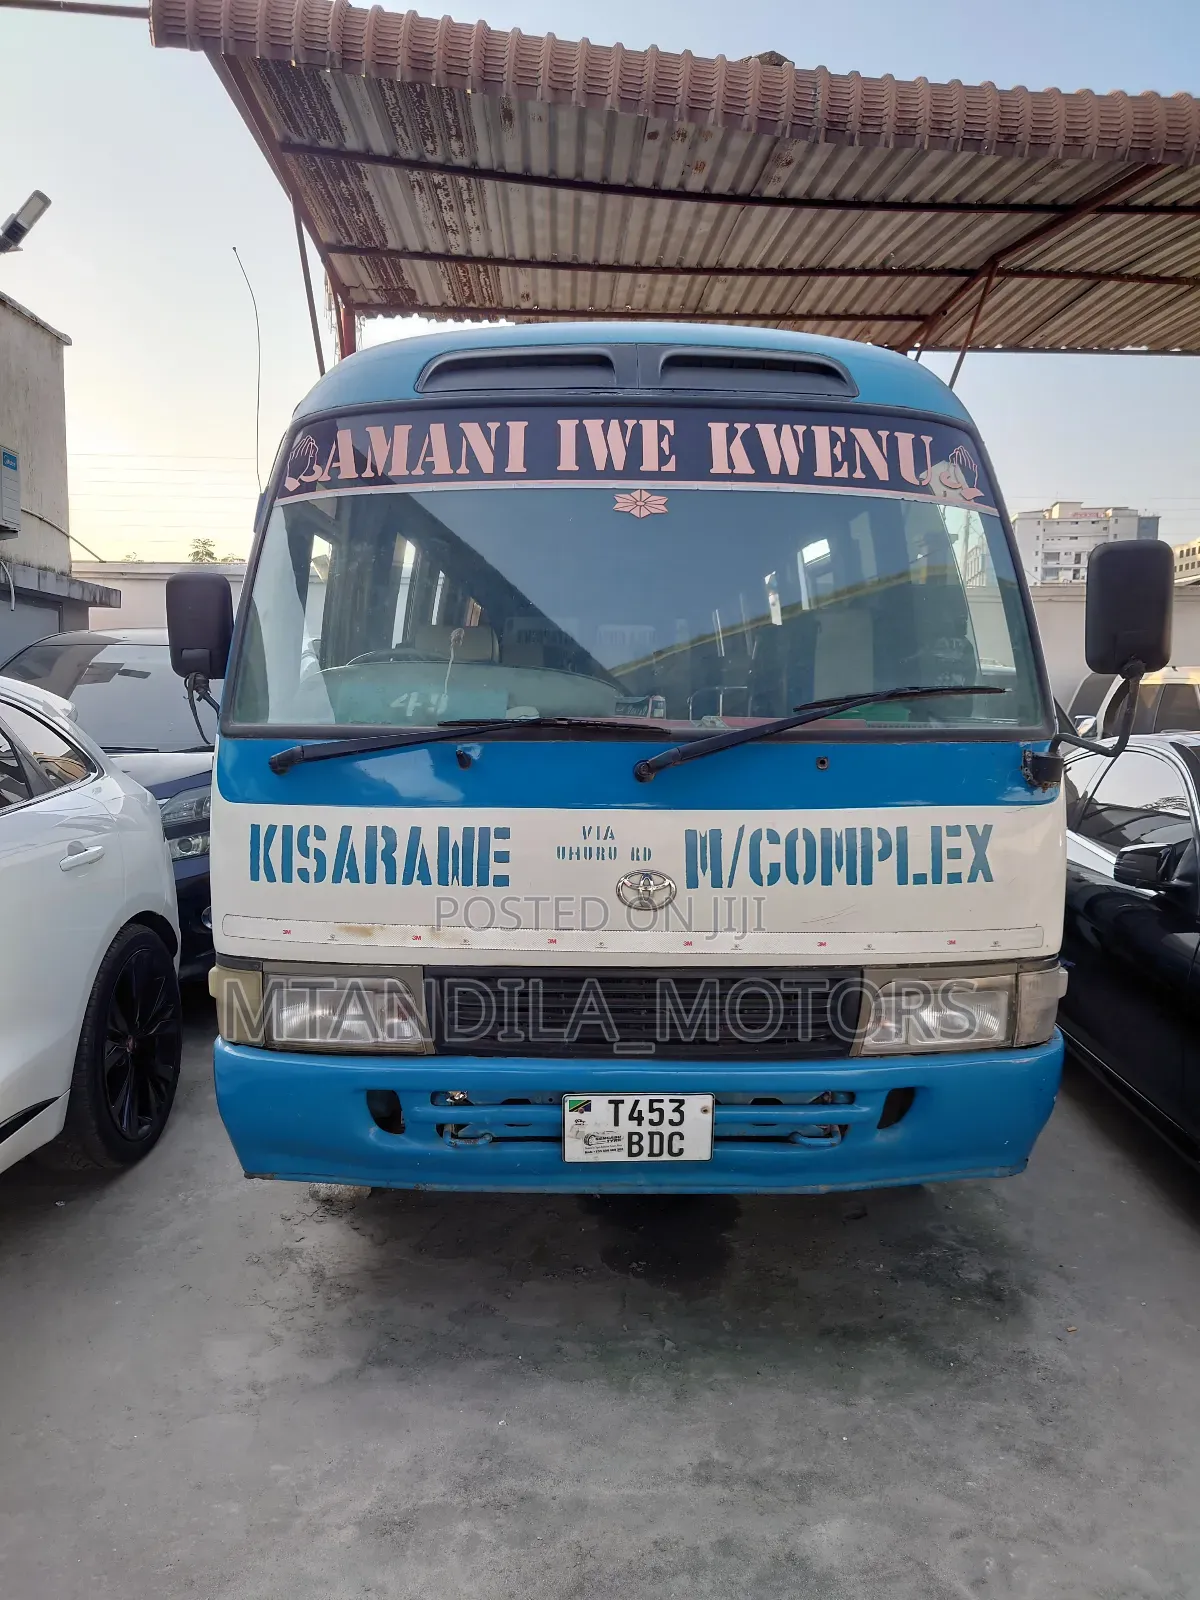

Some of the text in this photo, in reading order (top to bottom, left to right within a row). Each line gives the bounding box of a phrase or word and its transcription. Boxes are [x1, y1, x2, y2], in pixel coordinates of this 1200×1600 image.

[317, 419, 933, 486] AMANI IWE KWENU
[582, 825, 615, 840] VIA
[556, 846, 617, 861] UHURU
[684, 824, 994, 889] M/COMPLEX
[608, 1098, 686, 1127] T453
[627, 1131, 685, 1158] BDC
